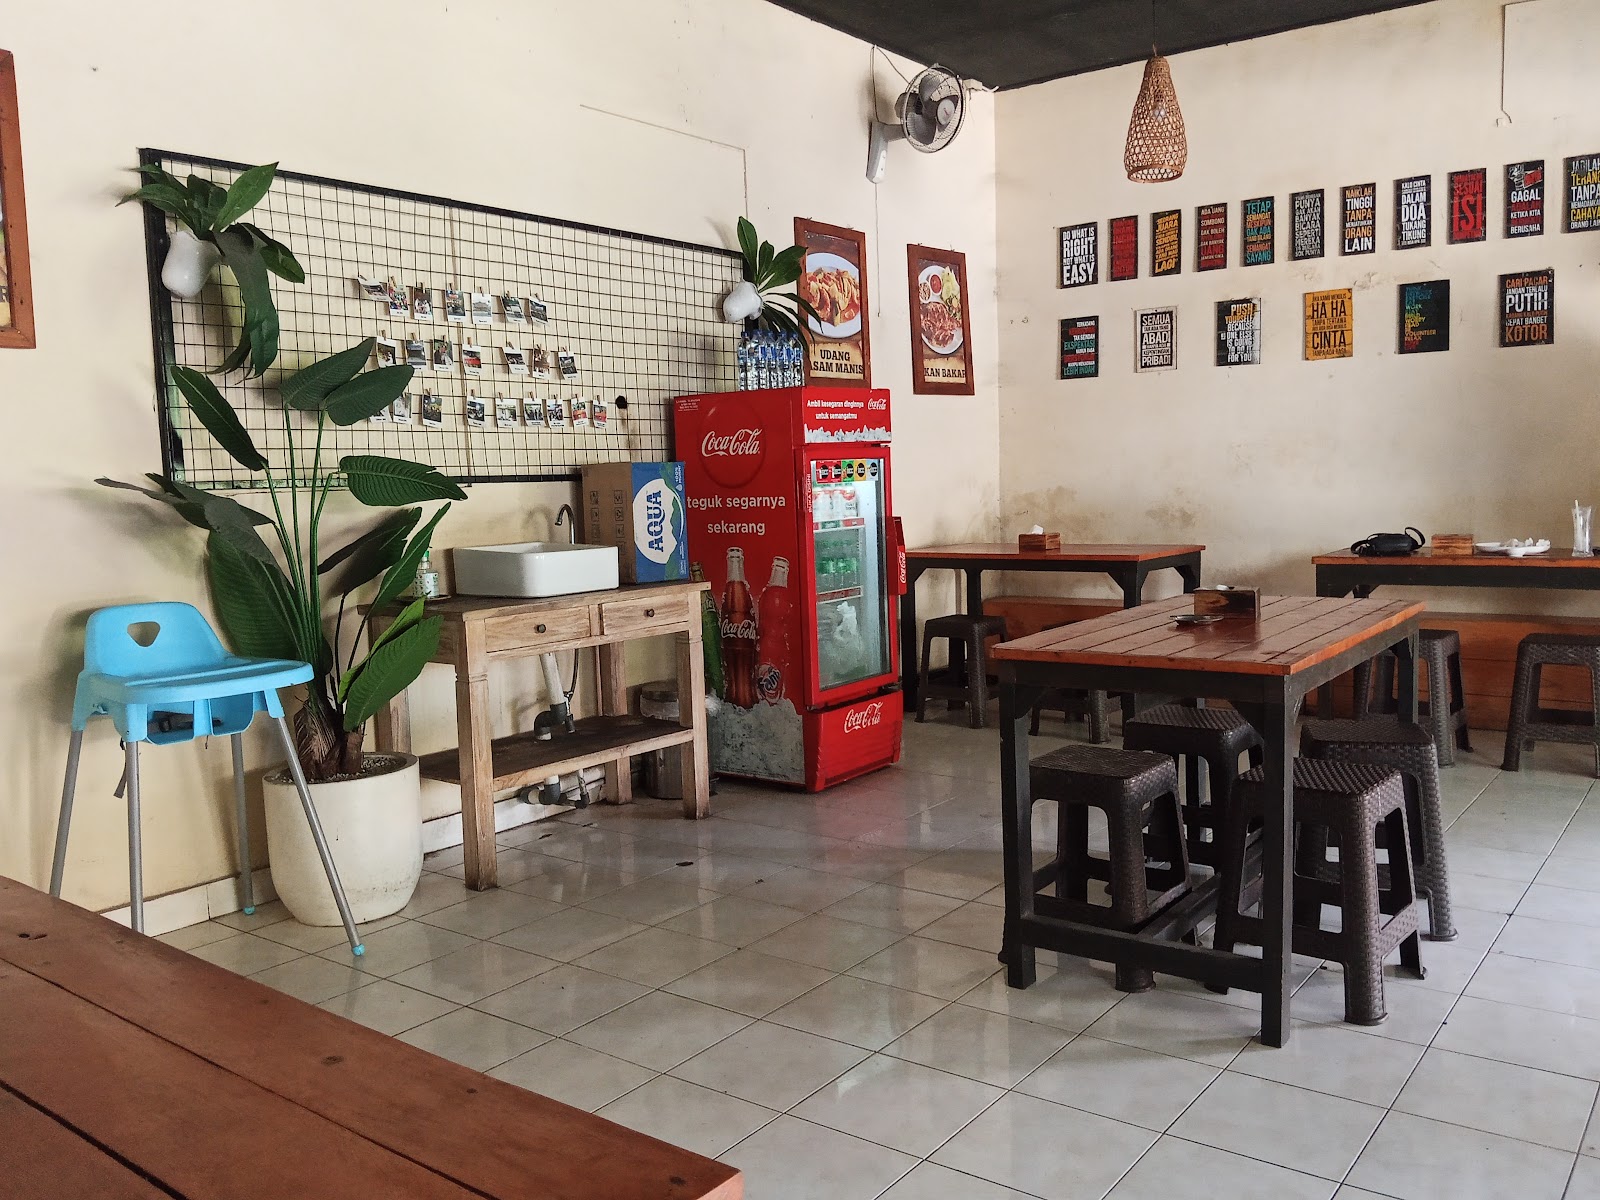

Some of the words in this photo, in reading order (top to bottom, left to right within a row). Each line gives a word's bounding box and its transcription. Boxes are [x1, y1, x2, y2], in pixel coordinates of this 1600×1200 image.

[1346, 187, 1372, 198] NAIKLAH
[1454, 180, 1482, 196] SESUAI
[1402, 192, 1426, 204] DALAM
[1511, 188, 1541, 203] GAGAL
[1246, 201, 1271, 214] TETAP
[1295, 198, 1320, 209] PUNYA
[1346, 196, 1372, 210] TINGGI
[1211, 206, 1224, 214] UANG
[1346, 208, 1372, 221] TANPA
[1402, 203, 1426, 222] DOA
[1453, 194, 1482, 232] ISI
[1510, 210, 1528, 219] KETIKA
[1529, 209, 1541, 217] KITA
[1247, 212, 1271, 221] SEMANGAT
[1295, 213, 1320, 222] BANYAK
[1156, 220, 1178, 233] JUARA
[1295, 221, 1320, 231] BICARA
[1402, 220, 1426, 231] TUKANG
[1510, 223, 1541, 235] BERUSAHA
[1063, 231, 1071, 240] DO
[1072, 228, 1087, 239] WHAT
[1089, 227, 1094, 237] IS
[1295, 229, 1320, 240] SEPERTI
[1346, 226, 1372, 239] ORANG
[1402, 229, 1426, 241] TIKUNG
[1063, 237, 1094, 258] RIGHT
[1201, 244, 1224, 256] UANG
[1247, 243, 1271, 252] SEMANGAT
[1345, 237, 1372, 252] LAIN
[1063, 257, 1073, 265] NOT
[1074, 255, 1088, 264] WHAT
[1090, 254, 1094, 262] IS
[1246, 251, 1271, 263] SAYANG
[1063, 262, 1095, 285] EASY
[1506, 278, 1523, 289] CARI
[1524, 276, 1548, 287] PACAR
[1506, 292, 1547, 313] PUTIH
[1231, 303, 1253, 316] PUSH
[1312, 302, 1327, 319] HA
[1331, 300, 1346, 317] HA
[1142, 314, 1170, 325] SEMUA
[1225, 314, 1252, 324] YOURSELF
[1506, 317, 1523, 326] CEPAT
[1525, 315, 1547, 324] BANGET
[1228, 322, 1252, 332] BECAUSE
[1506, 324, 1548, 342] KOTOR
[1142, 332, 1170, 345] ABADI
[1227, 331, 1238, 340] ONE
[1240, 330, 1252, 339] ELSE
[1312, 330, 1346, 349] CINTA
[1235, 337, 1252, 346] GOING
[820, 349, 850, 361] UDANG
[1142, 355, 1170, 366] PRIBADI
[1228, 354, 1239, 362] FOR
[1240, 352, 1251, 361] YOU
[835, 363, 863, 374] MANIS
[924, 367, 940, 377] KAN
[687, 495, 722, 510] teguk
[726, 496, 786, 509] segarnya
[647, 490, 665, 552] AQUA
[708, 521, 765, 535] sekarang
